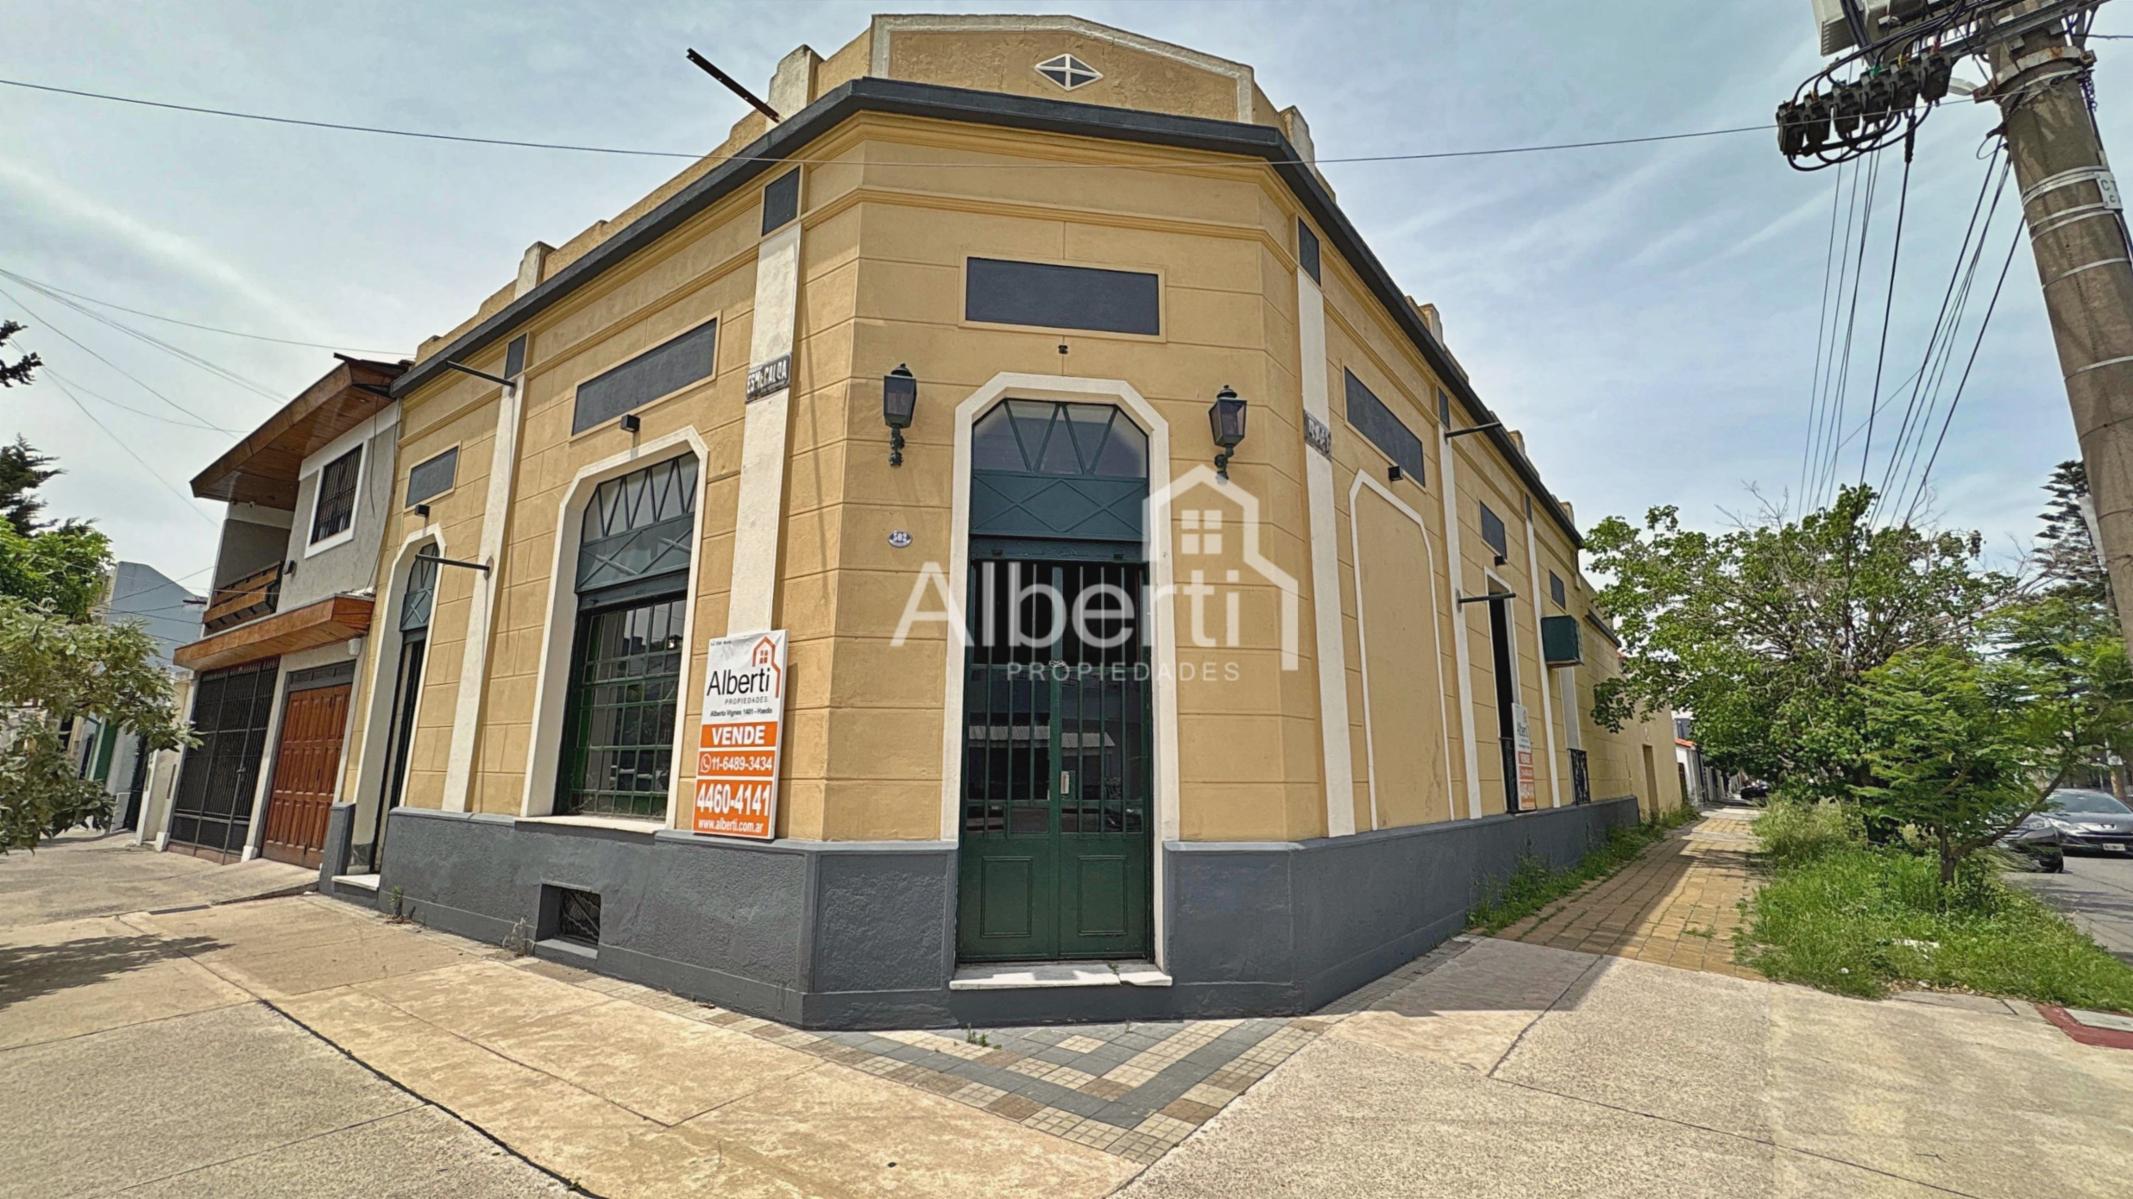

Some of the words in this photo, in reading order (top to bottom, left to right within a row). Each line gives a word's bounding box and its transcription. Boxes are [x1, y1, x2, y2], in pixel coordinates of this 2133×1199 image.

[706, 667, 770, 697] Alberti
[724, 696, 769, 705] PROPIEDADES
[711, 725, 766, 746] VENDE
[711, 755, 773, 772] 11-6489-3434
[696, 783, 771, 817] 4460-4141
[698, 816, 765, 834] www.alberti.com.ar
